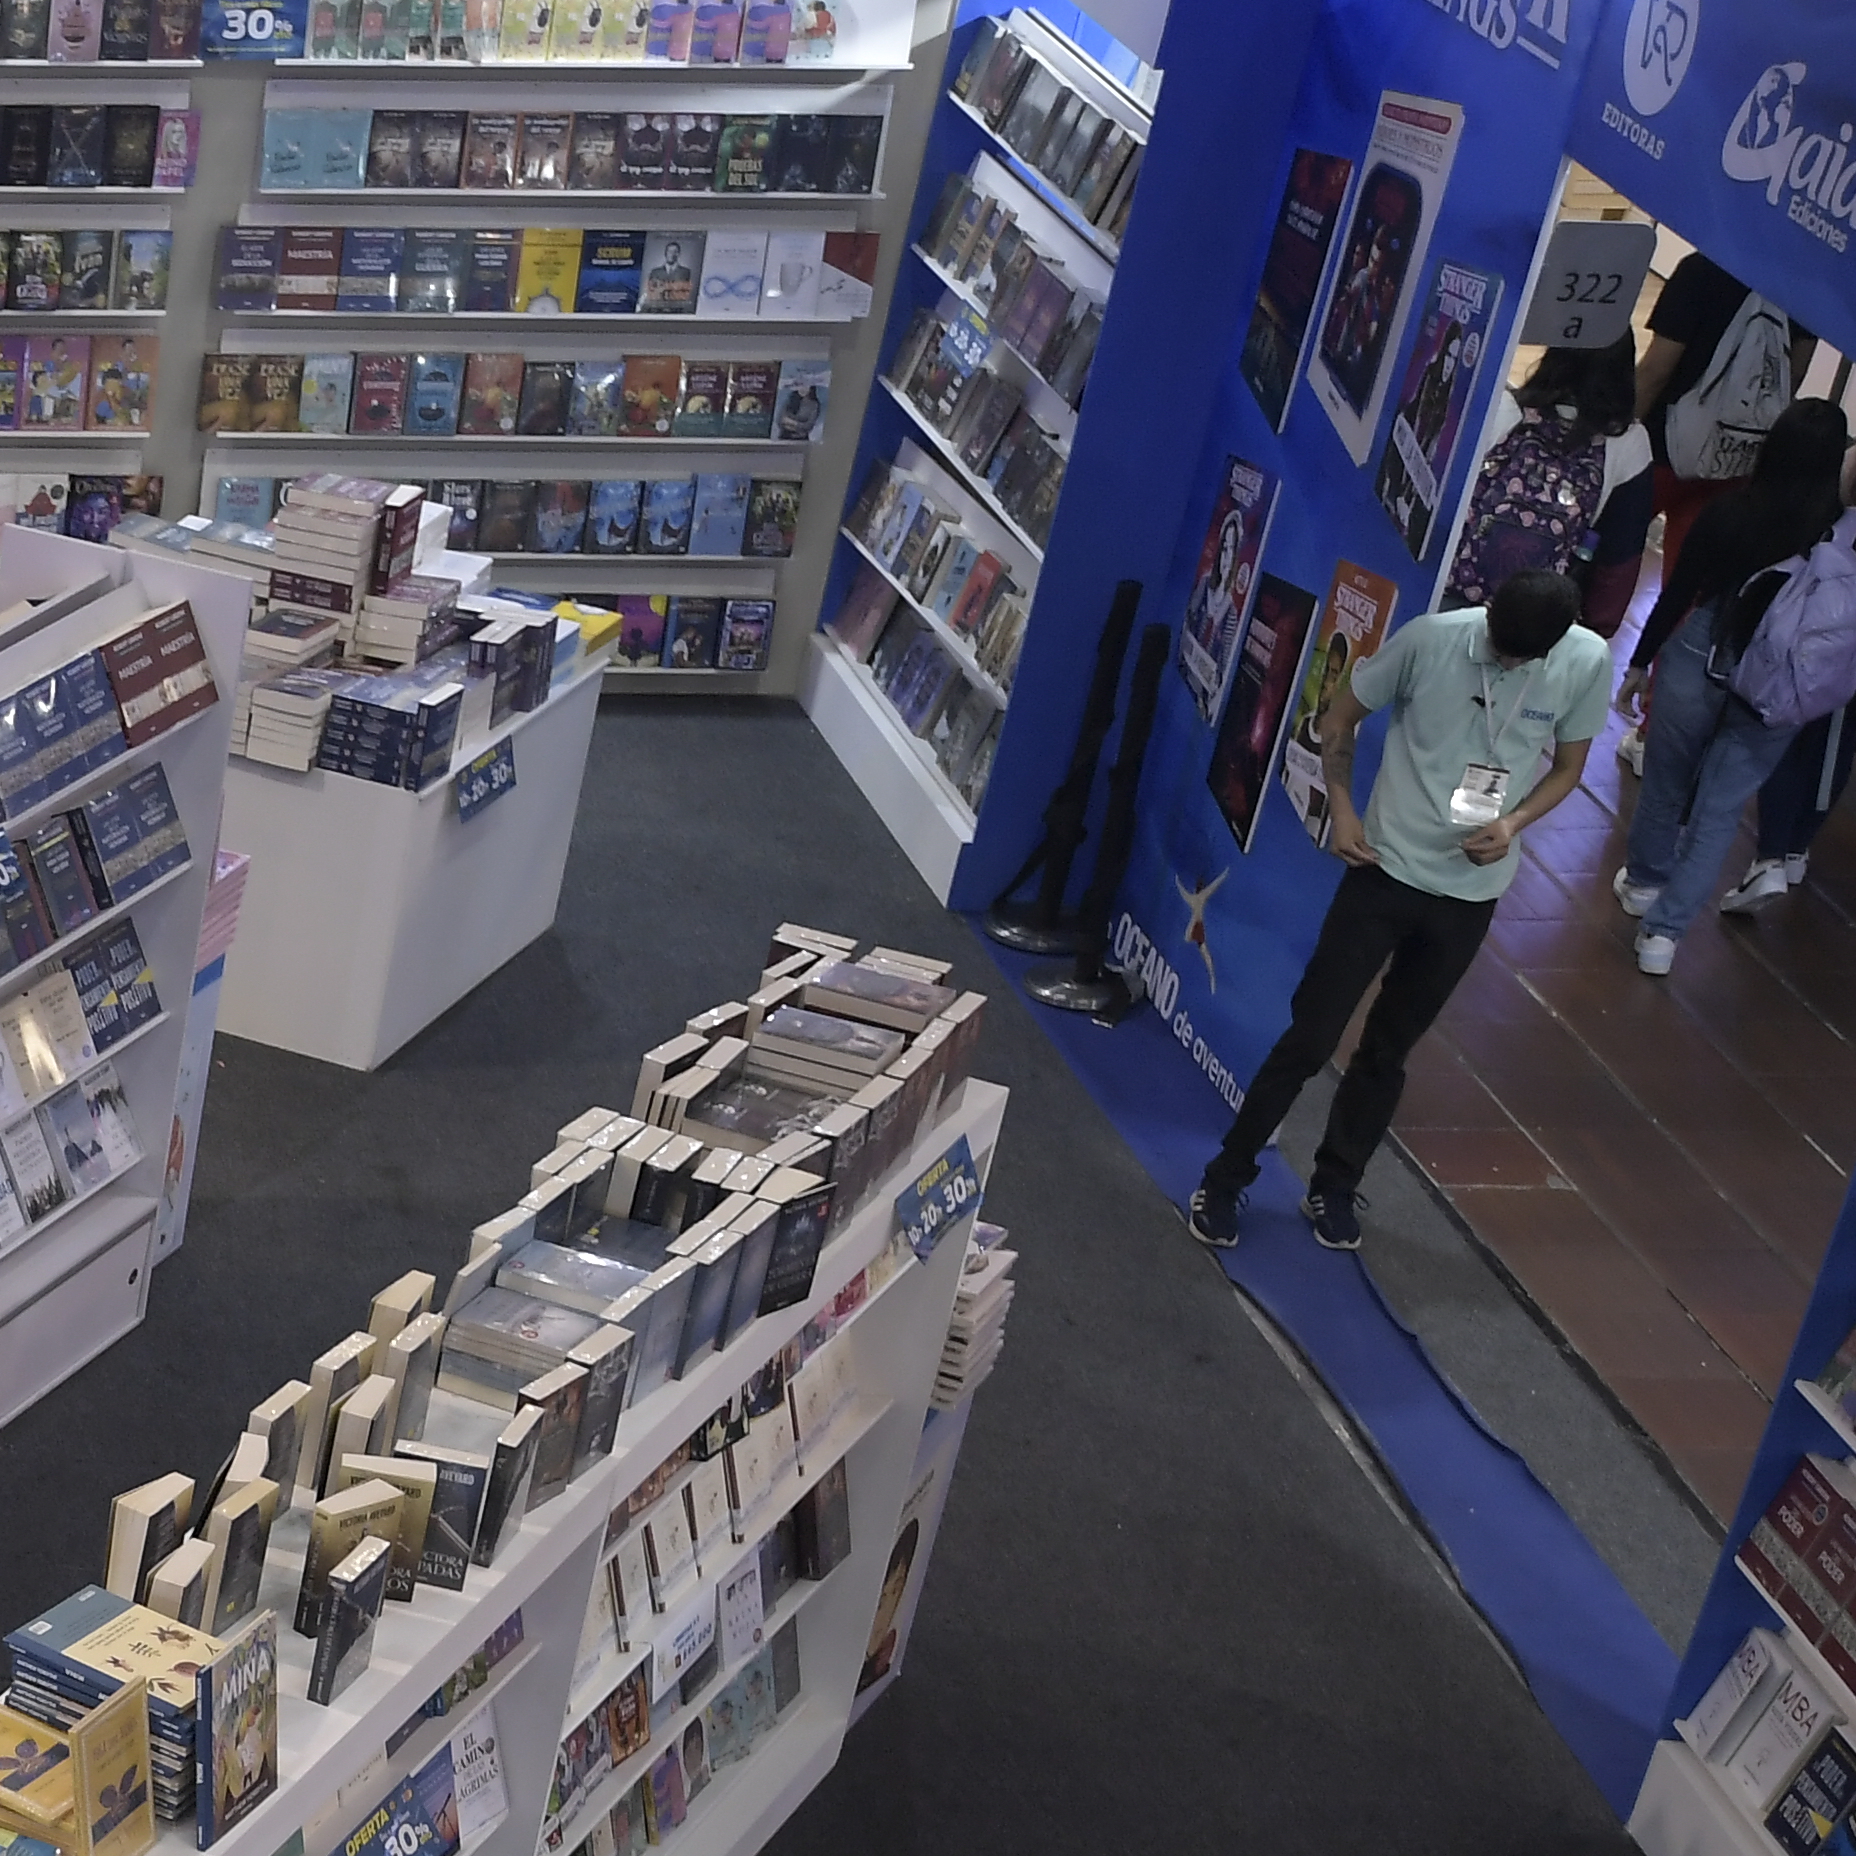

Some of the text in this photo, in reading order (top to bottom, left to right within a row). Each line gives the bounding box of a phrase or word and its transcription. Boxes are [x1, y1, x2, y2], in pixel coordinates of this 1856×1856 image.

[221, 11, 292, 41] 30%
[1602, 103, 1666, 160] EDITORAS
[1788, 198, 1848, 253] Ediciones
[1439, 264, 1487, 306] STRANGER
[1557, 273, 1623, 304] 322
[1563, 314, 1583, 339] a
[1114, 912, 1194, 1048] OCEANO de
[916, 1158, 949, 1194] OFERTA
[221, 1655, 273, 1706] MINA
[1781, 1679, 1819, 1734] MBA
[463, 1733, 478, 1751] EL
